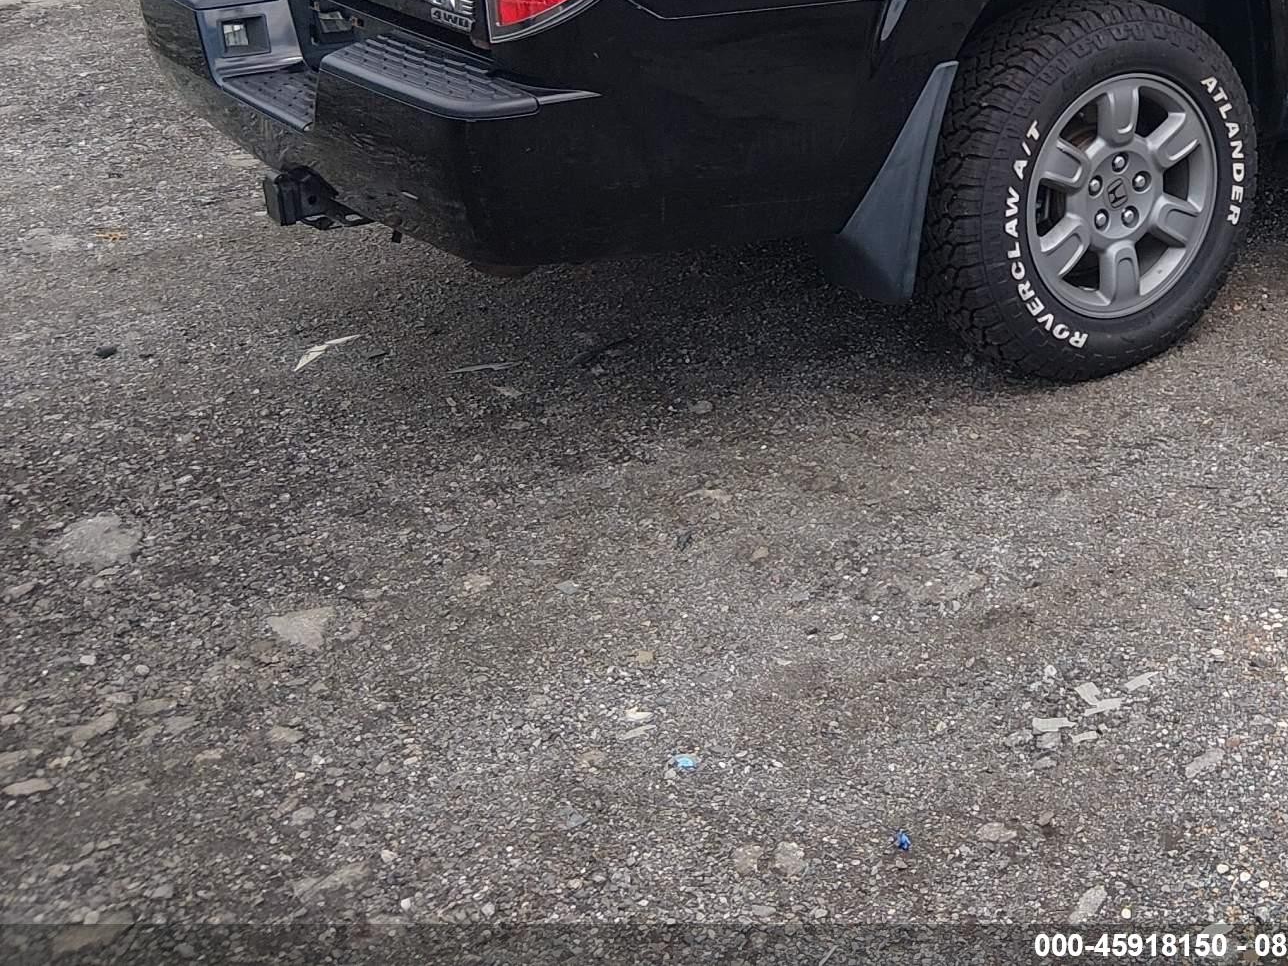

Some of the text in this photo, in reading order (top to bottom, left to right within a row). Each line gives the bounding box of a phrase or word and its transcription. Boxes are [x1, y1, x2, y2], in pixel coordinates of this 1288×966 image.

[430, 7, 475, 32] 4WD
[1200, 76, 1245, 226] ATLANDER
[1005, 120, 1088, 349] ROVERCLAW A/T
